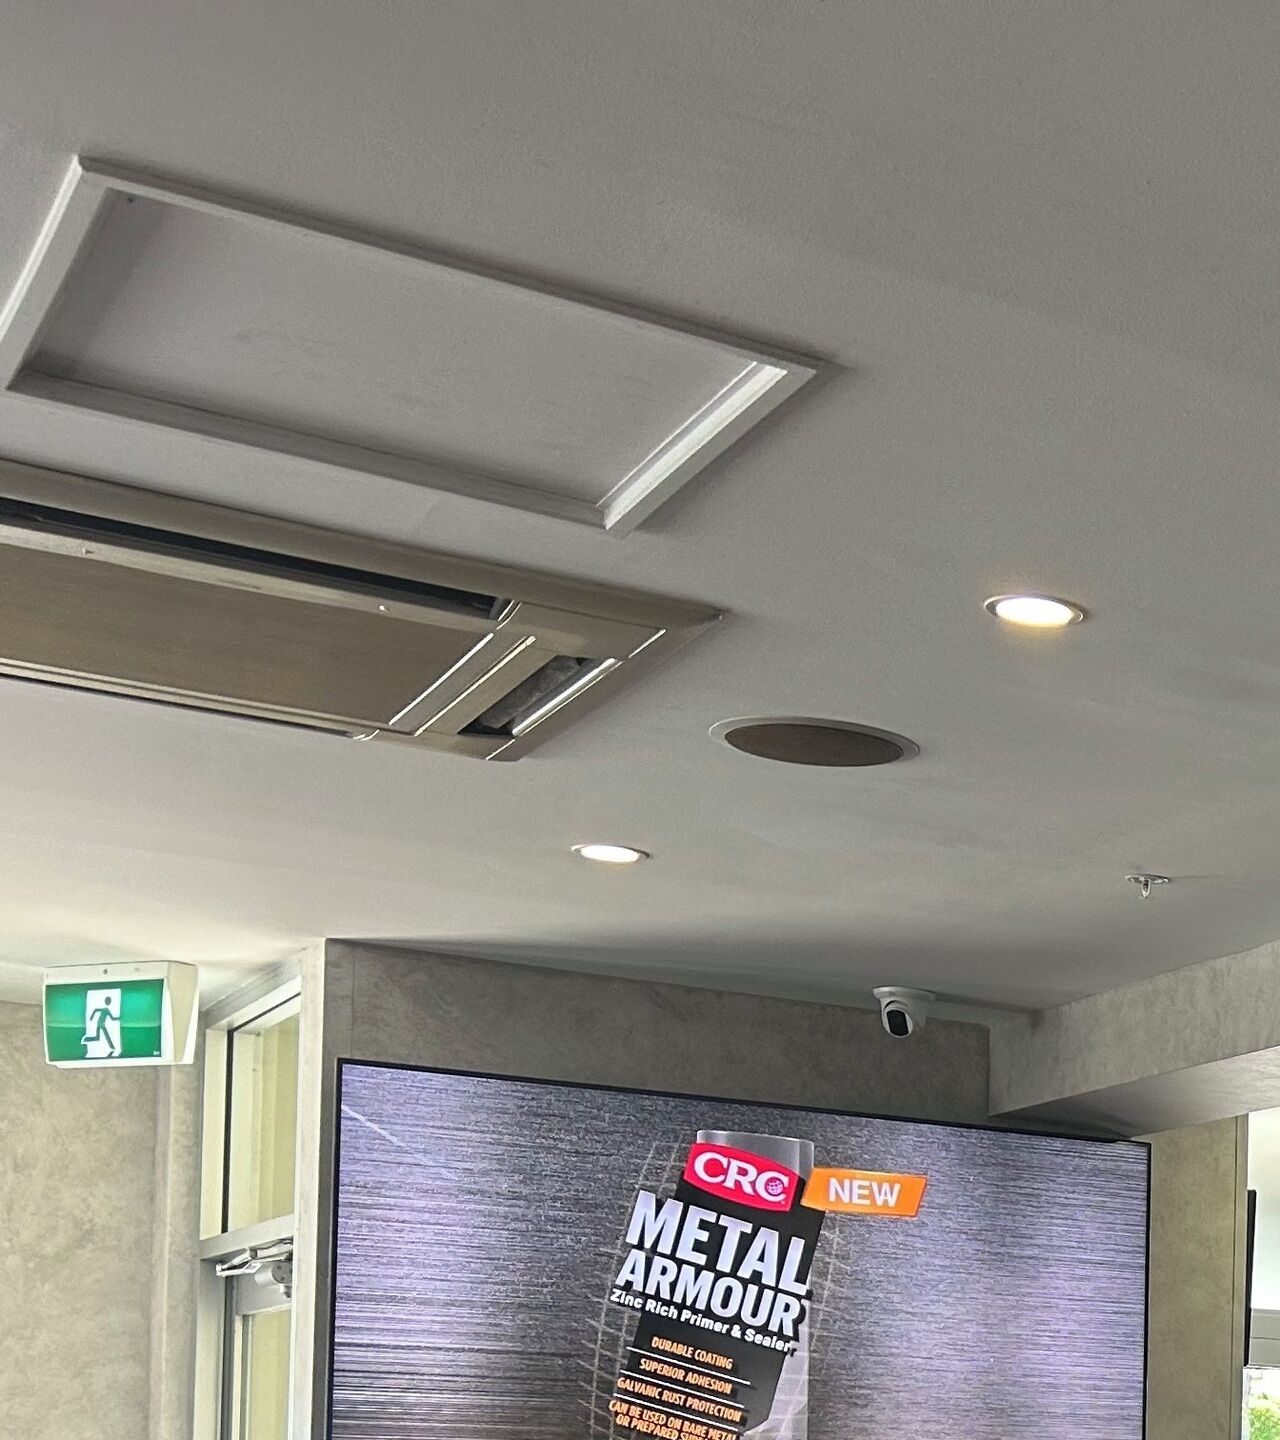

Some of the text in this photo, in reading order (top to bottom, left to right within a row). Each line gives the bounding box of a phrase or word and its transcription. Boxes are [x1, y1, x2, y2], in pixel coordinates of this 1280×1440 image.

[694, 1152, 788, 1202] CRC
[828, 1177, 900, 1207] NEW
[626, 1190, 810, 1295] METAL
[615, 1249, 801, 1336] ARMOUR
[610, 1289, 792, 1352] Zinc Rich Primer & Sealer
[651, 1336, 733, 1370] DURABLE COATING
[640, 1358, 732, 1394] SUPERIOR ADHESION
[609, 1400, 627, 1415] CAN
[629, 1406, 642, 1418] BE
[643, 1409, 666, 1425] USED
[667, 1417, 682, 1429] ON
[683, 1421, 707, 1437] BARE
[617, 1377, 742, 1422] GALVANIC RUST PROTECTION
[616, 1414, 630, 1426] OR
[631, 1417, 679, 1440] PREPARED
